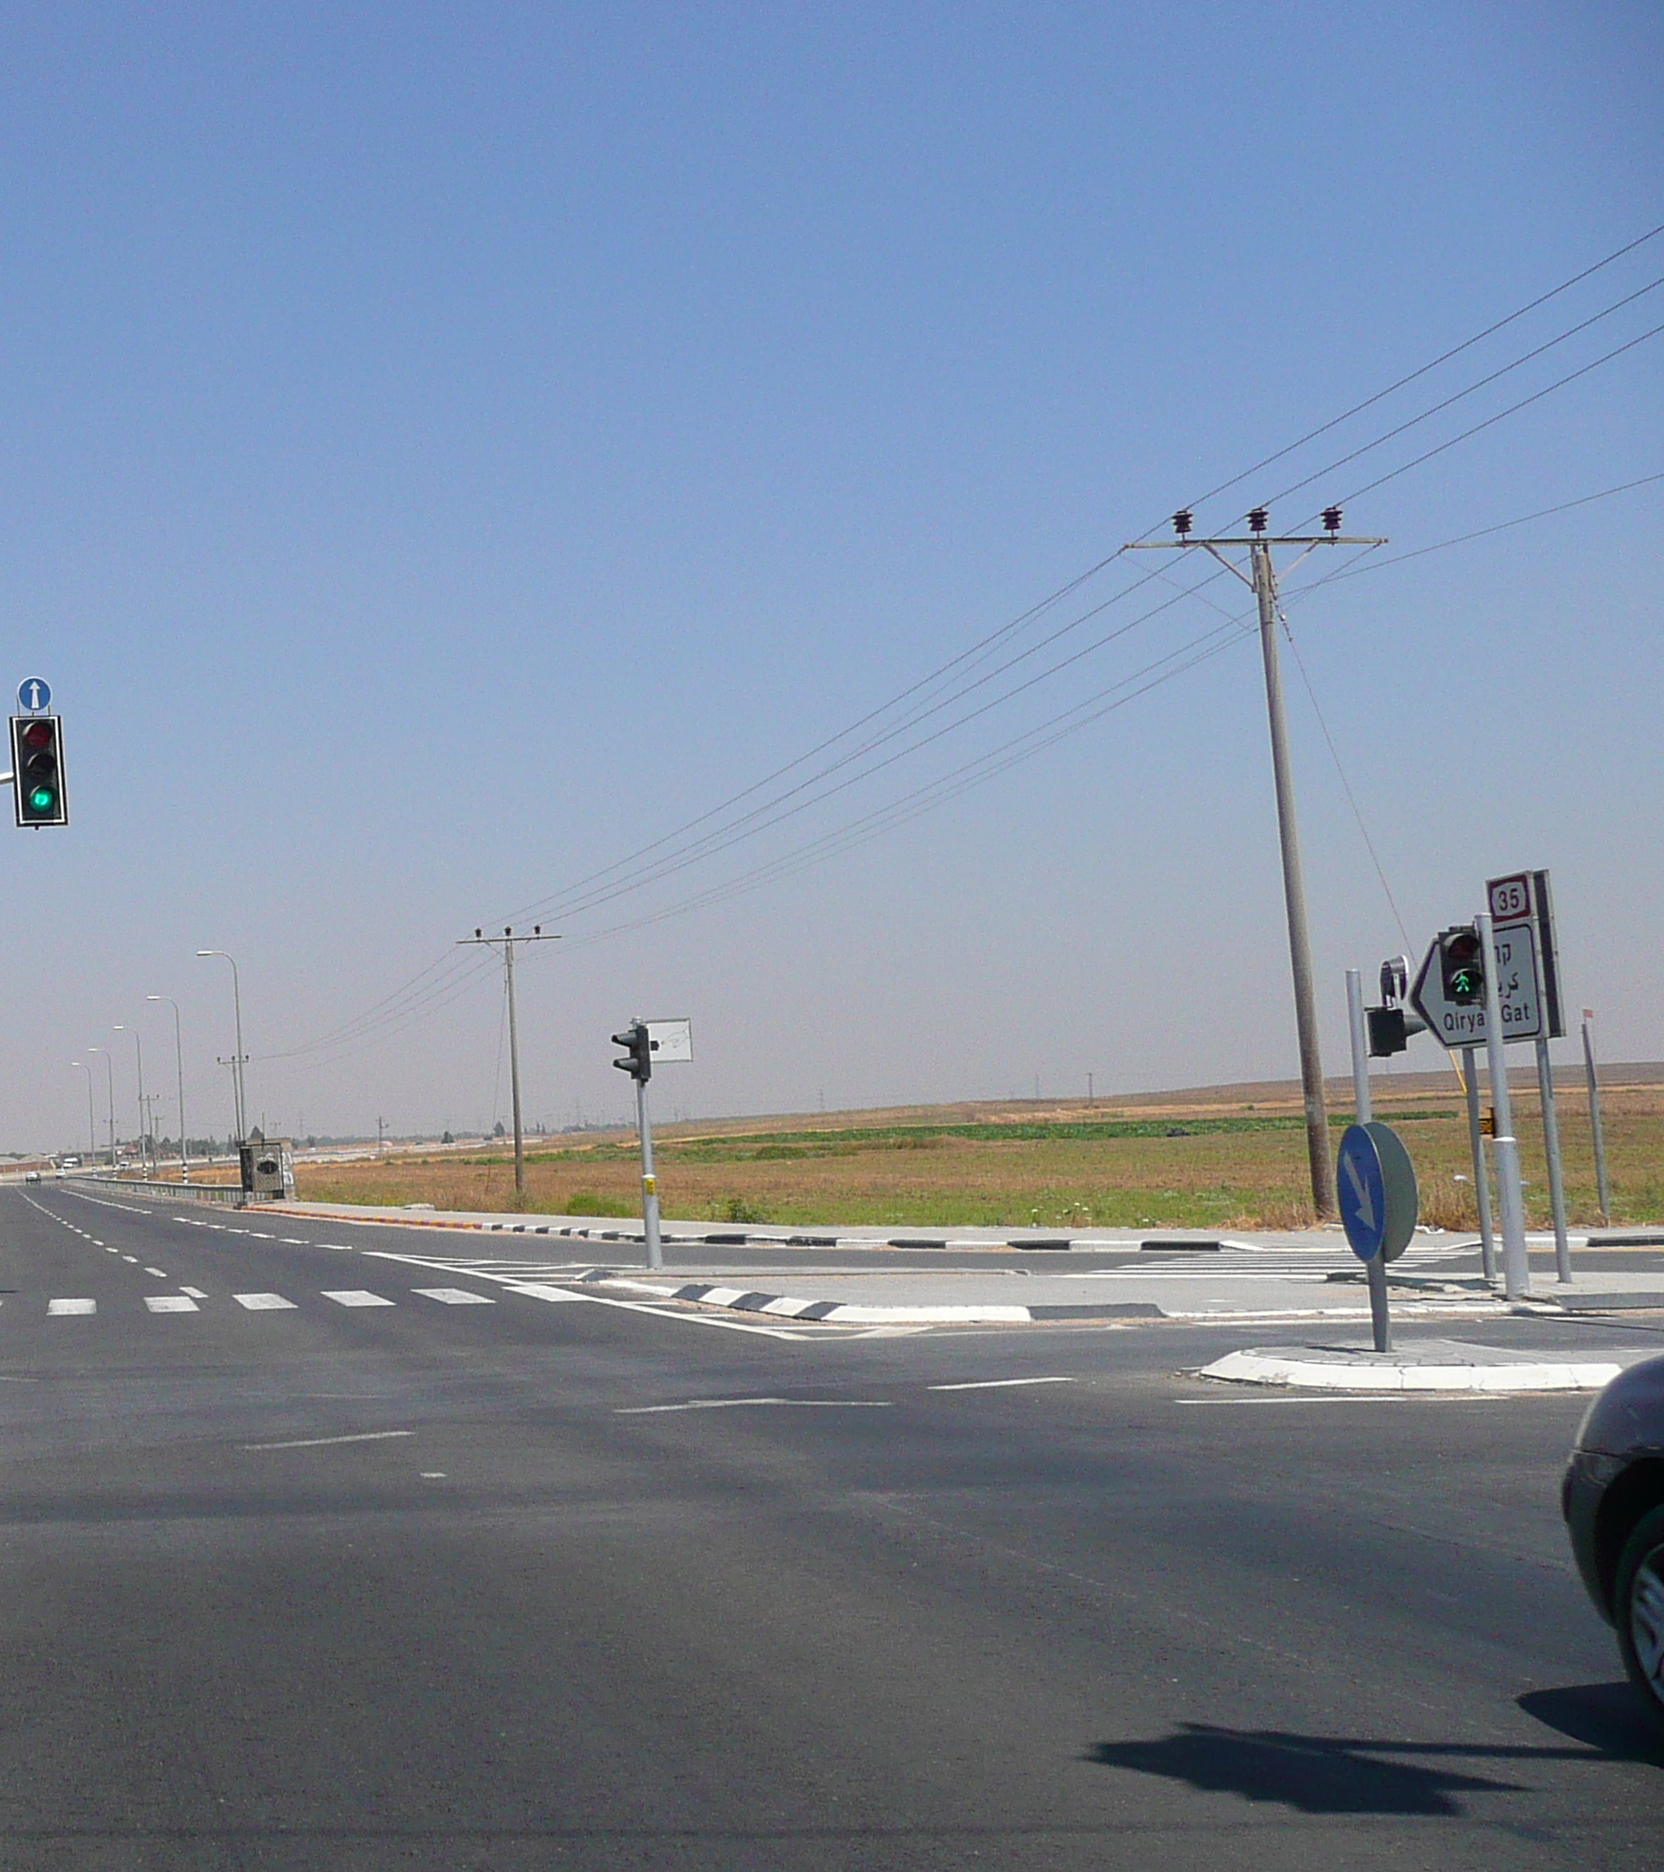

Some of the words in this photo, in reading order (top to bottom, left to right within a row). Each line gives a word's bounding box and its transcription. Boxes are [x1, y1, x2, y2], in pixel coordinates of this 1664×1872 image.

[1499, 889, 1519, 911] 35
[1444, 1012, 1485, 1033] Qirya
[1501, 1003, 1530, 1023] Gat
